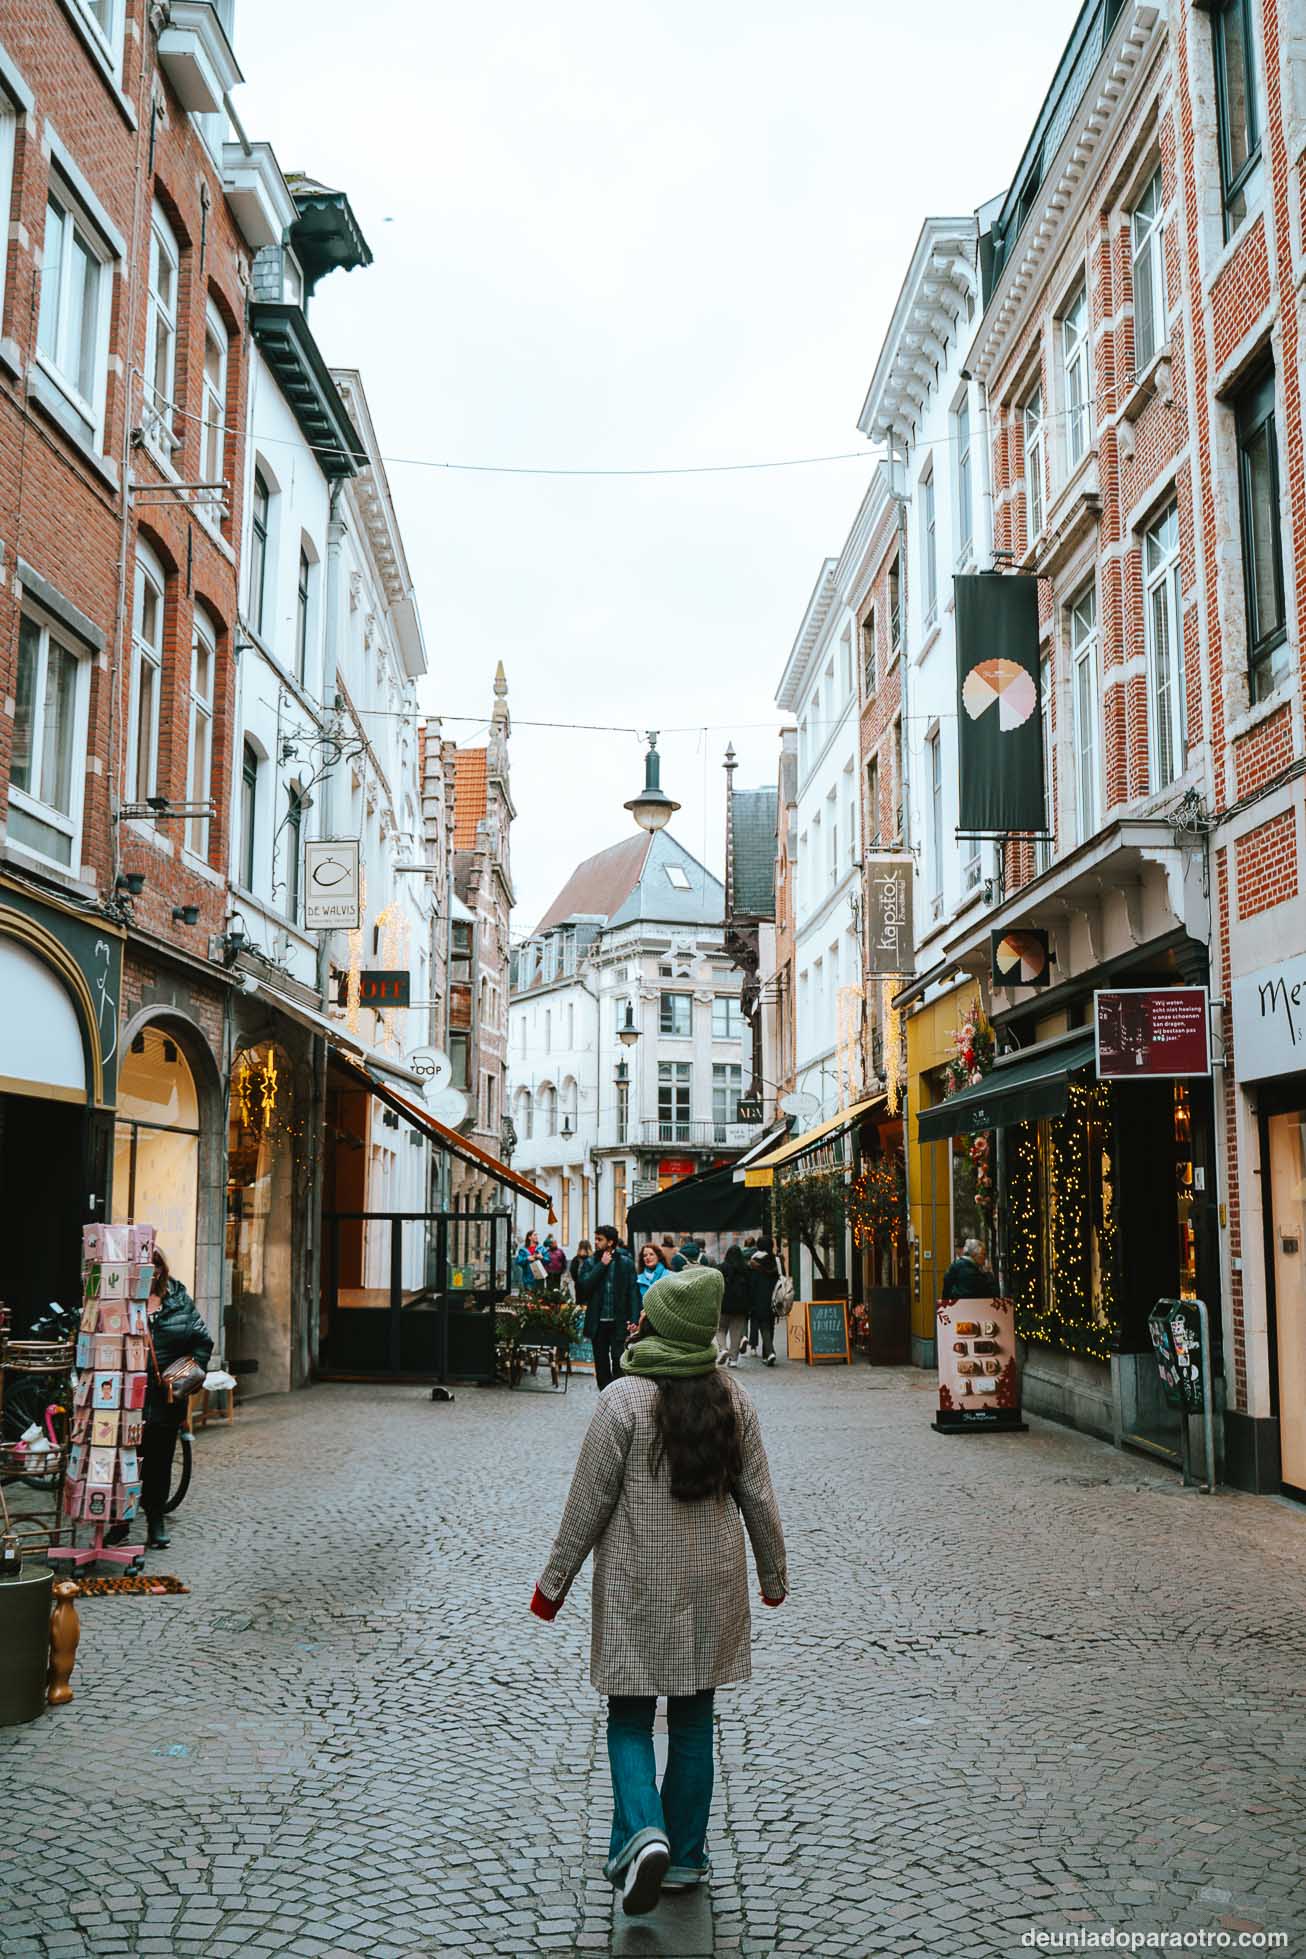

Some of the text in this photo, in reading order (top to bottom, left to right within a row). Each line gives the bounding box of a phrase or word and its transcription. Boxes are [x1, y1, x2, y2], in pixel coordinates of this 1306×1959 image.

[308, 905, 356, 916] DE WALVIS
[873, 870, 904, 949] Kapstok
[1259, 977, 1306, 1046] Me
